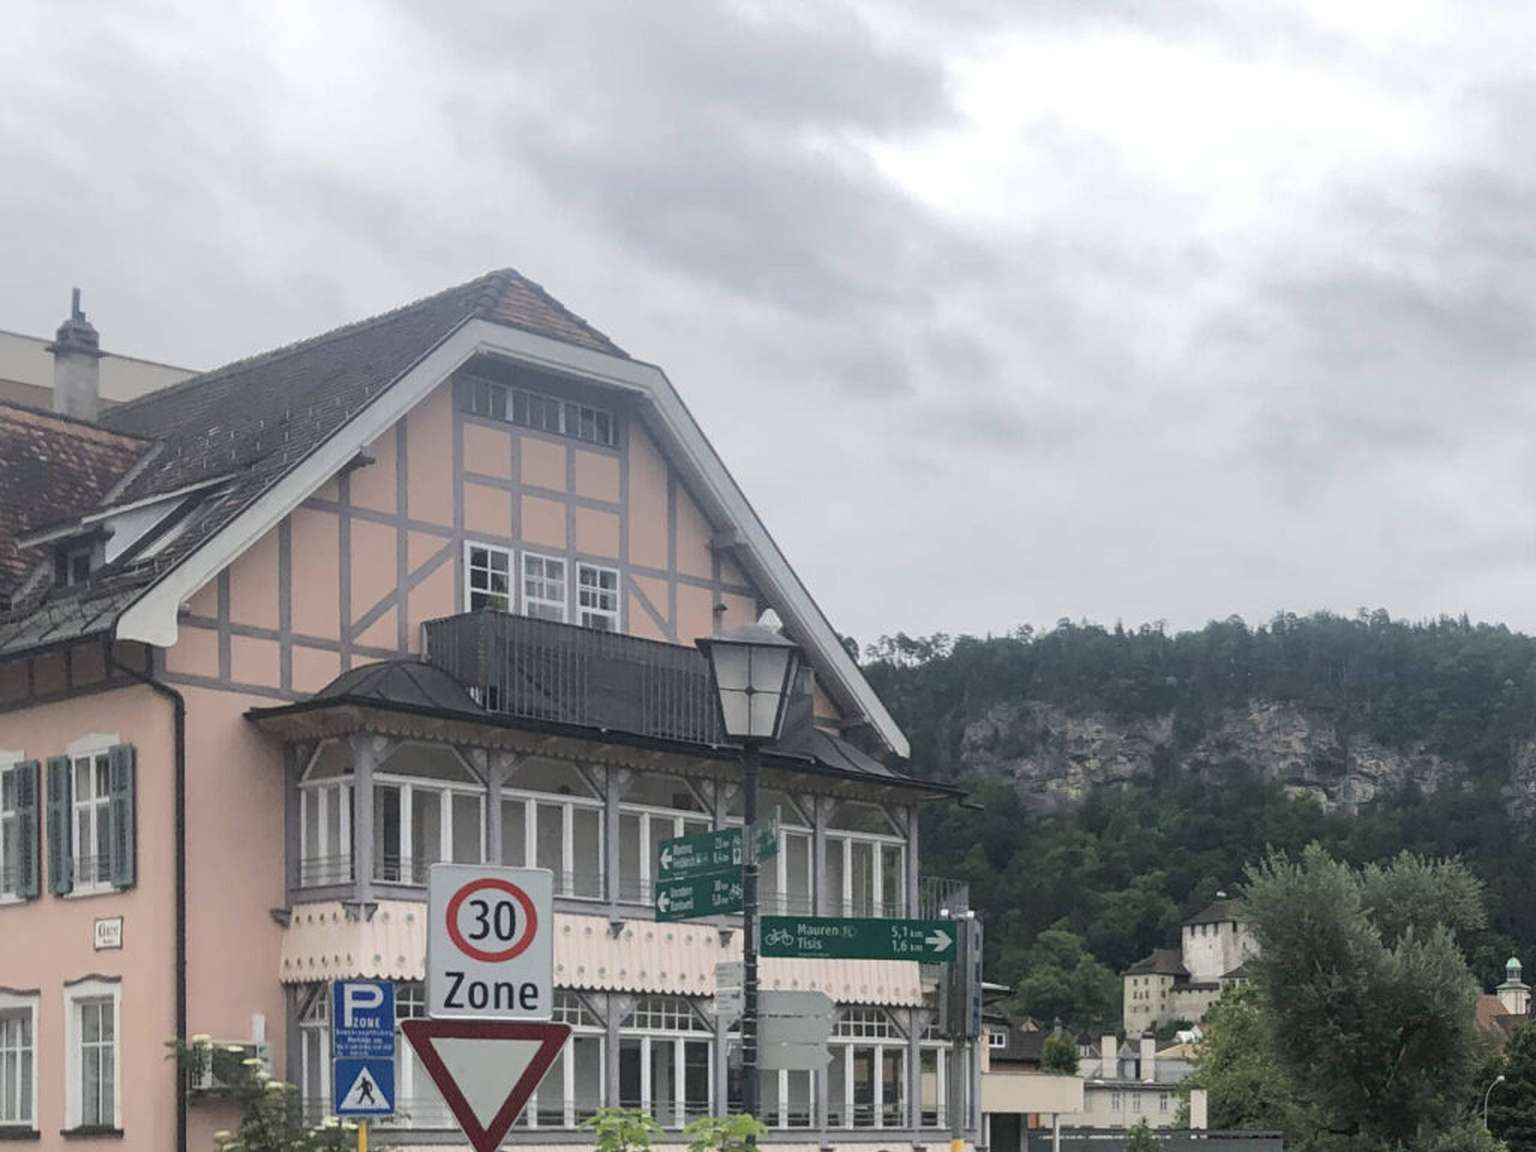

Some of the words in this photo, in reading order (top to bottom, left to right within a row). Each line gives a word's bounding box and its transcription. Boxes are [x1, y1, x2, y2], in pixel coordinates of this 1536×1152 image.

[469, 900, 516, 941] 30
[797, 924, 839, 937] Mauren
[891, 926, 908, 938] 5,1
[797, 937, 823, 950] Tisis
[444, 972, 538, 1010] Zone
[344, 984, 384, 1028] P
[353, 1017, 380, 1029] ZONE
